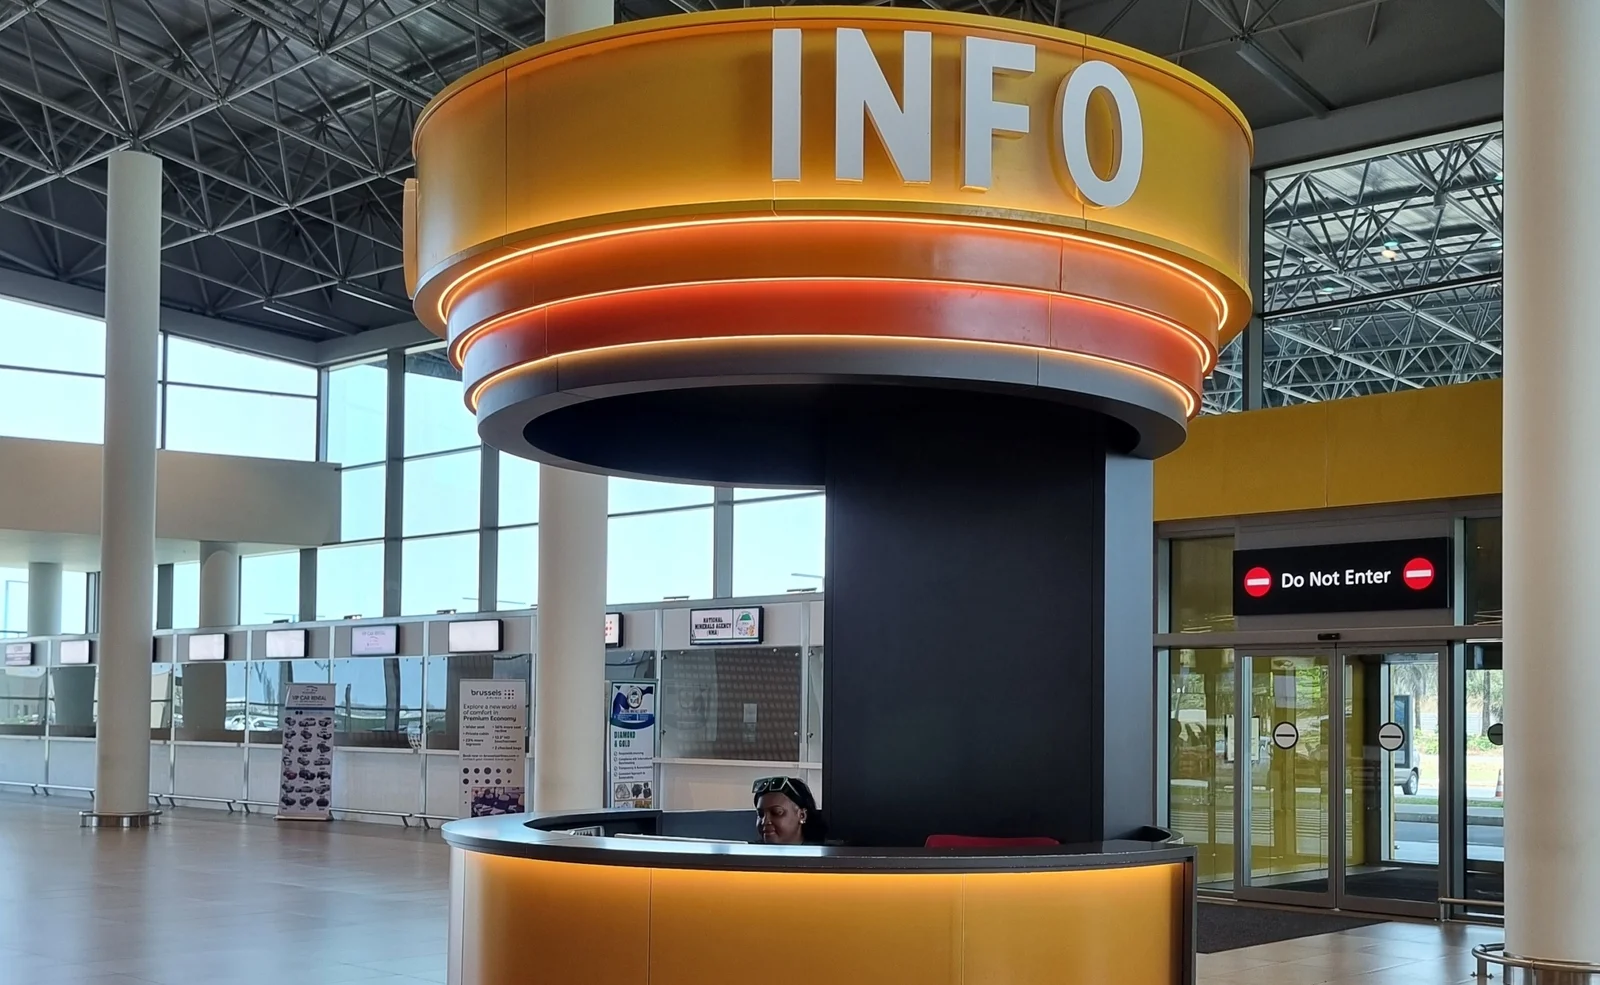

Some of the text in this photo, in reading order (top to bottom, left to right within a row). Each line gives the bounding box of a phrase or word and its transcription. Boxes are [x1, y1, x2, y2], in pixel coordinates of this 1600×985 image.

[771, 27, 1144, 208] INFO
[1281, 569, 1391, 588] Do Not Enter
[614, 731, 636, 739] DIAMOND
[618, 740, 631, 748] GOLD
